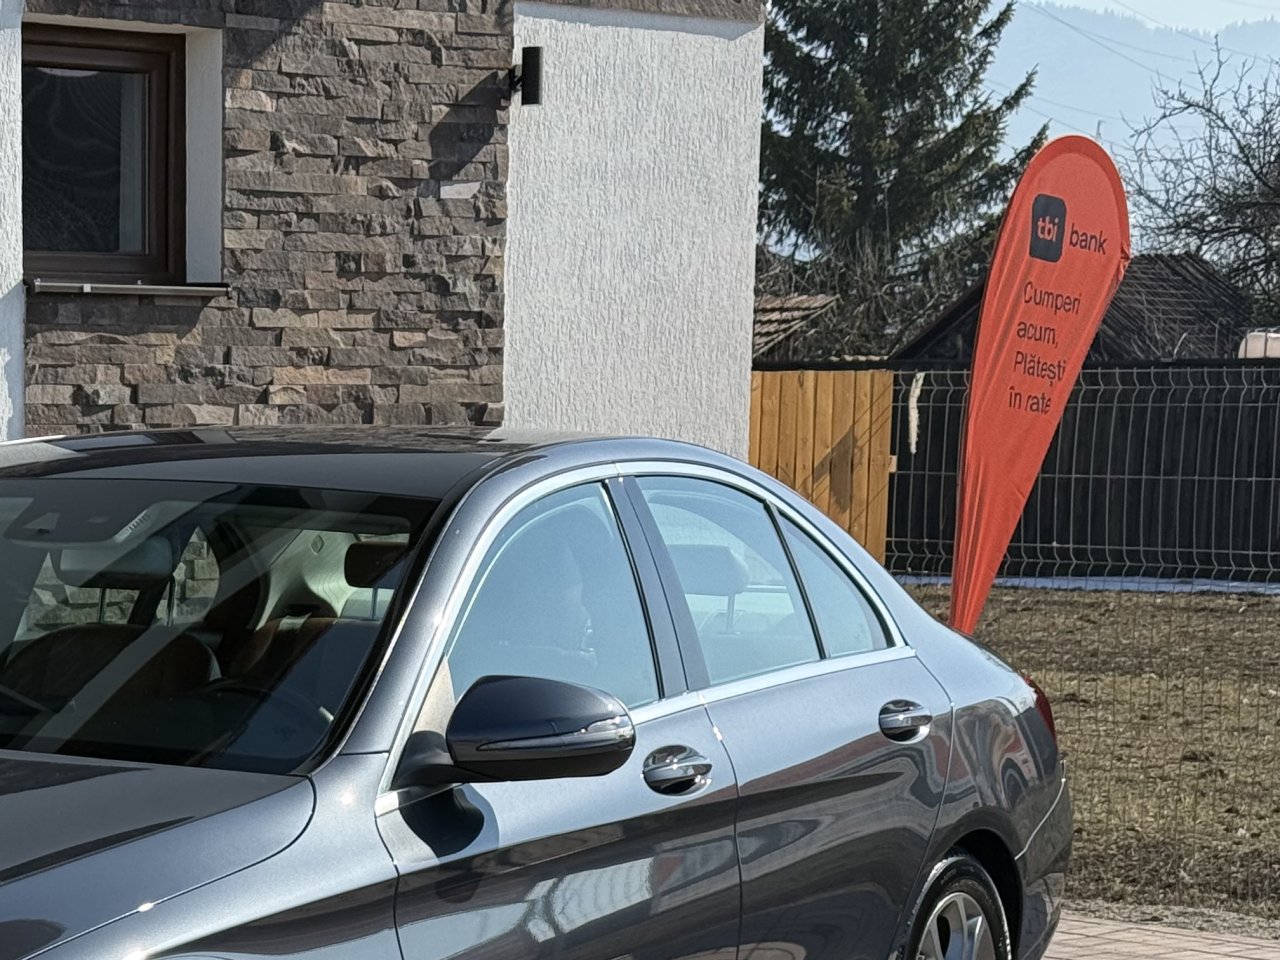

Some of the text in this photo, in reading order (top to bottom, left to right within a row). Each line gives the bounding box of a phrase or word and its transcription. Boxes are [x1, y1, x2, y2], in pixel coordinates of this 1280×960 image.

[1037, 216, 1107, 255] tbi bank
[1024, 281, 1082, 315] Cumperi
[1017, 320, 1059, 348] acum,
[1014, 350, 1066, 387] Plătești
[1009, 386, 1051, 415] în rate
